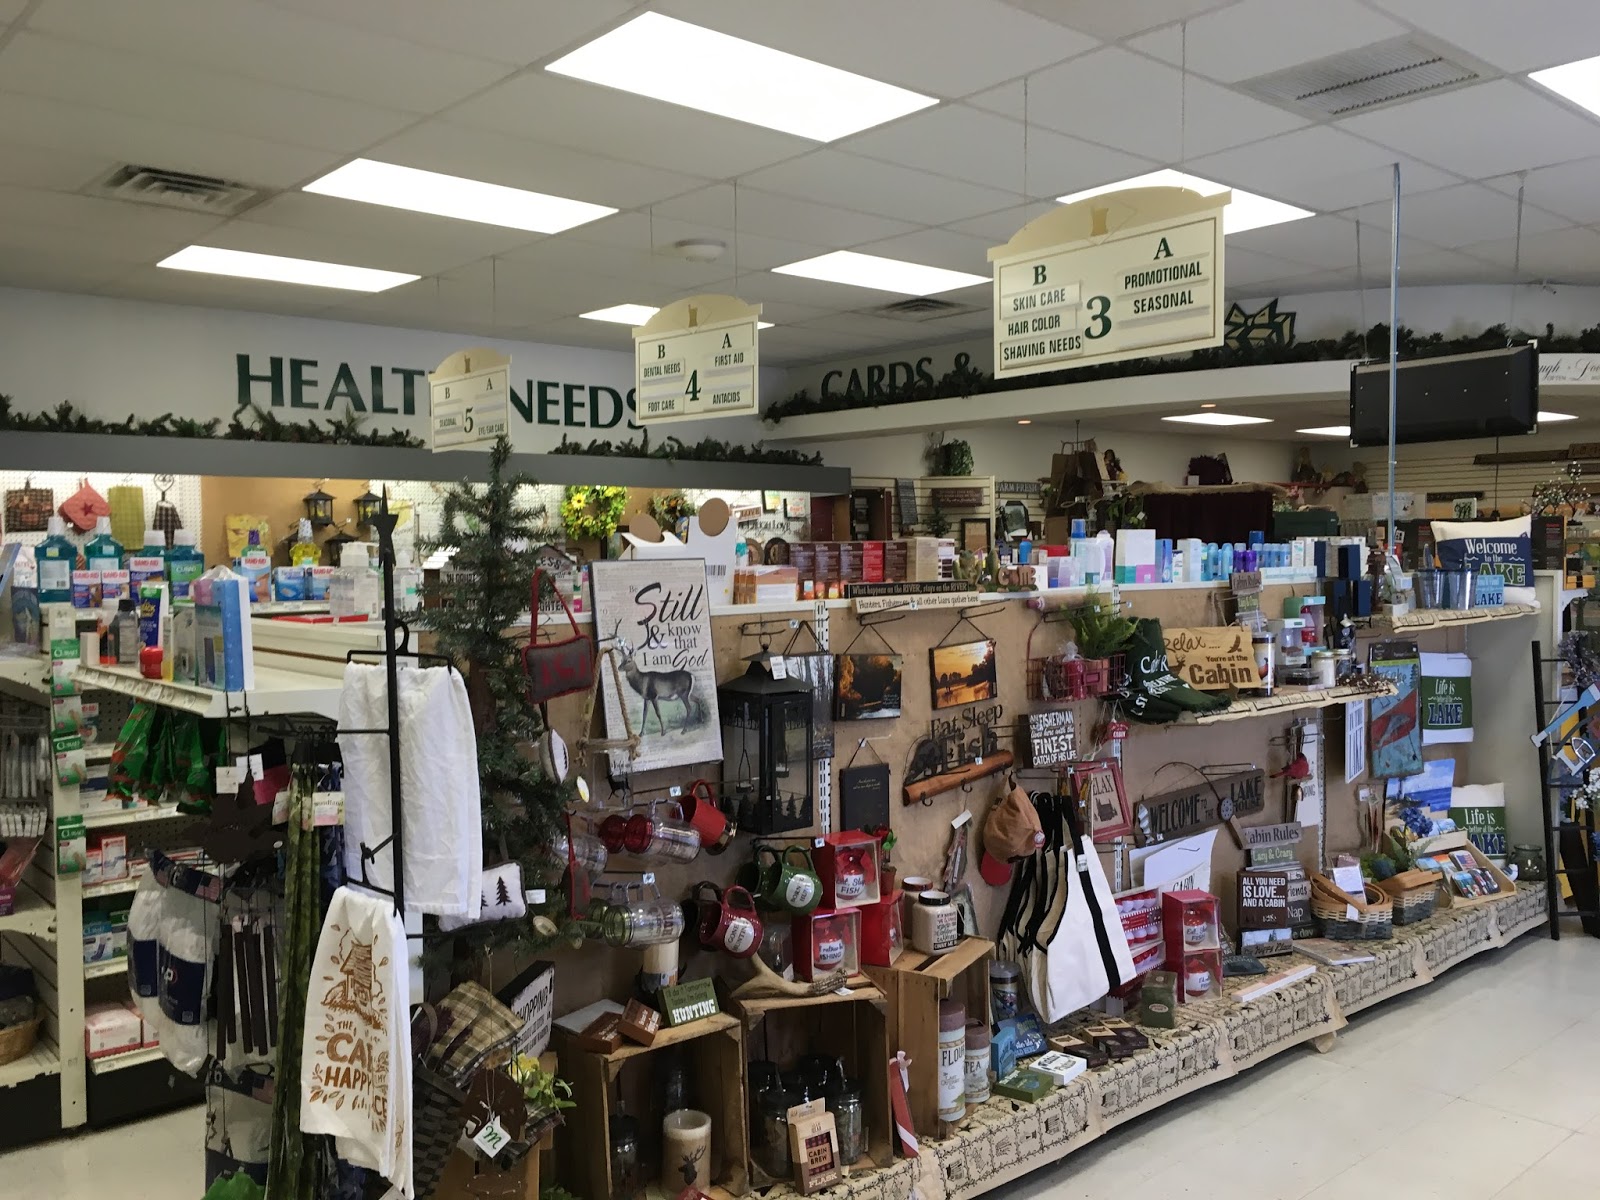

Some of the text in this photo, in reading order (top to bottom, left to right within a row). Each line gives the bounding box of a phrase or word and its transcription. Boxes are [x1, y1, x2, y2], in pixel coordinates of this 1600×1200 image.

[1153, 237, 1173, 260] A
[1032, 264, 1047, 286] B
[1124, 261, 1202, 290] PROMOTIONAL
[1012, 288, 1066, 312] SKIN CARE
[1133, 289, 1194, 314] SEASONAL
[1007, 315, 1061, 336] HAIR COLOR
[1084, 295, 1112, 339] 3
[722, 333, 732, 349] A
[1003, 335, 1081, 361] SHAVING NEEDS
[657, 344, 666, 359] B
[715, 352, 744, 367] FIRST AID
[643, 362, 681, 378] DENTAL NEEDS
[821, 357, 933, 399] CARDS
[236, 353, 434, 416] HEALT
[684, 369, 701, 401] 4
[648, 400, 675, 412] FOOT CARE
[712, 392, 741, 405] ANTACIDS
[464, 406, 473, 434] 5
[1464, 538, 1518, 555] Welcome
[1492, 554, 1503, 562] the
[635, 582, 704, 625] Still
[667, 622, 702, 637] know
[674, 636, 698, 649] that
[643, 649, 708, 670] I am God
[1189, 663, 1252, 684] Cabin
[1435, 679, 1456, 695] Life is
[962, 704, 1003, 730] Sleep
[1039, 711, 1074, 728] FISHERMAN
[1428, 703, 1463, 725] LAKE
[1033, 734, 1074, 756] FINEST
[1032, 754, 1050, 766] CATCH
[1051, 753, 1057, 763] OF
[1067, 750, 1077, 760] LIFE
[1093, 774, 1114, 796] ELAX
[1231, 776, 1262, 804] LAKE
[1149, 793, 1200, 833] WELCOME
[1464, 808, 1496, 825] Life is
[1247, 826, 1299, 843] abin Rules
[1470, 833, 1506, 855] AKE
[1242, 877, 1286, 885] ALL YOU NEED
[1243, 886, 1285, 898] IS LOVE...
[1242, 899, 1286, 907] AND A CABIN
[1287, 906, 1304, 921] Nap
[728, 924, 740, 943] GONE
[820, 952, 842, 960] ISHING
[672, 999, 716, 1023] HUNTING
[336, 1020, 353, 1031] THE
[942, 1045, 965, 1067] FLOUR
[964, 1060, 981, 1074] TEA
[324, 1066, 372, 1096] HAPPY
[808, 1147, 827, 1158] CABIN
[810, 1155, 827, 1165] BREW
[808, 1172, 838, 1189] FLASK
